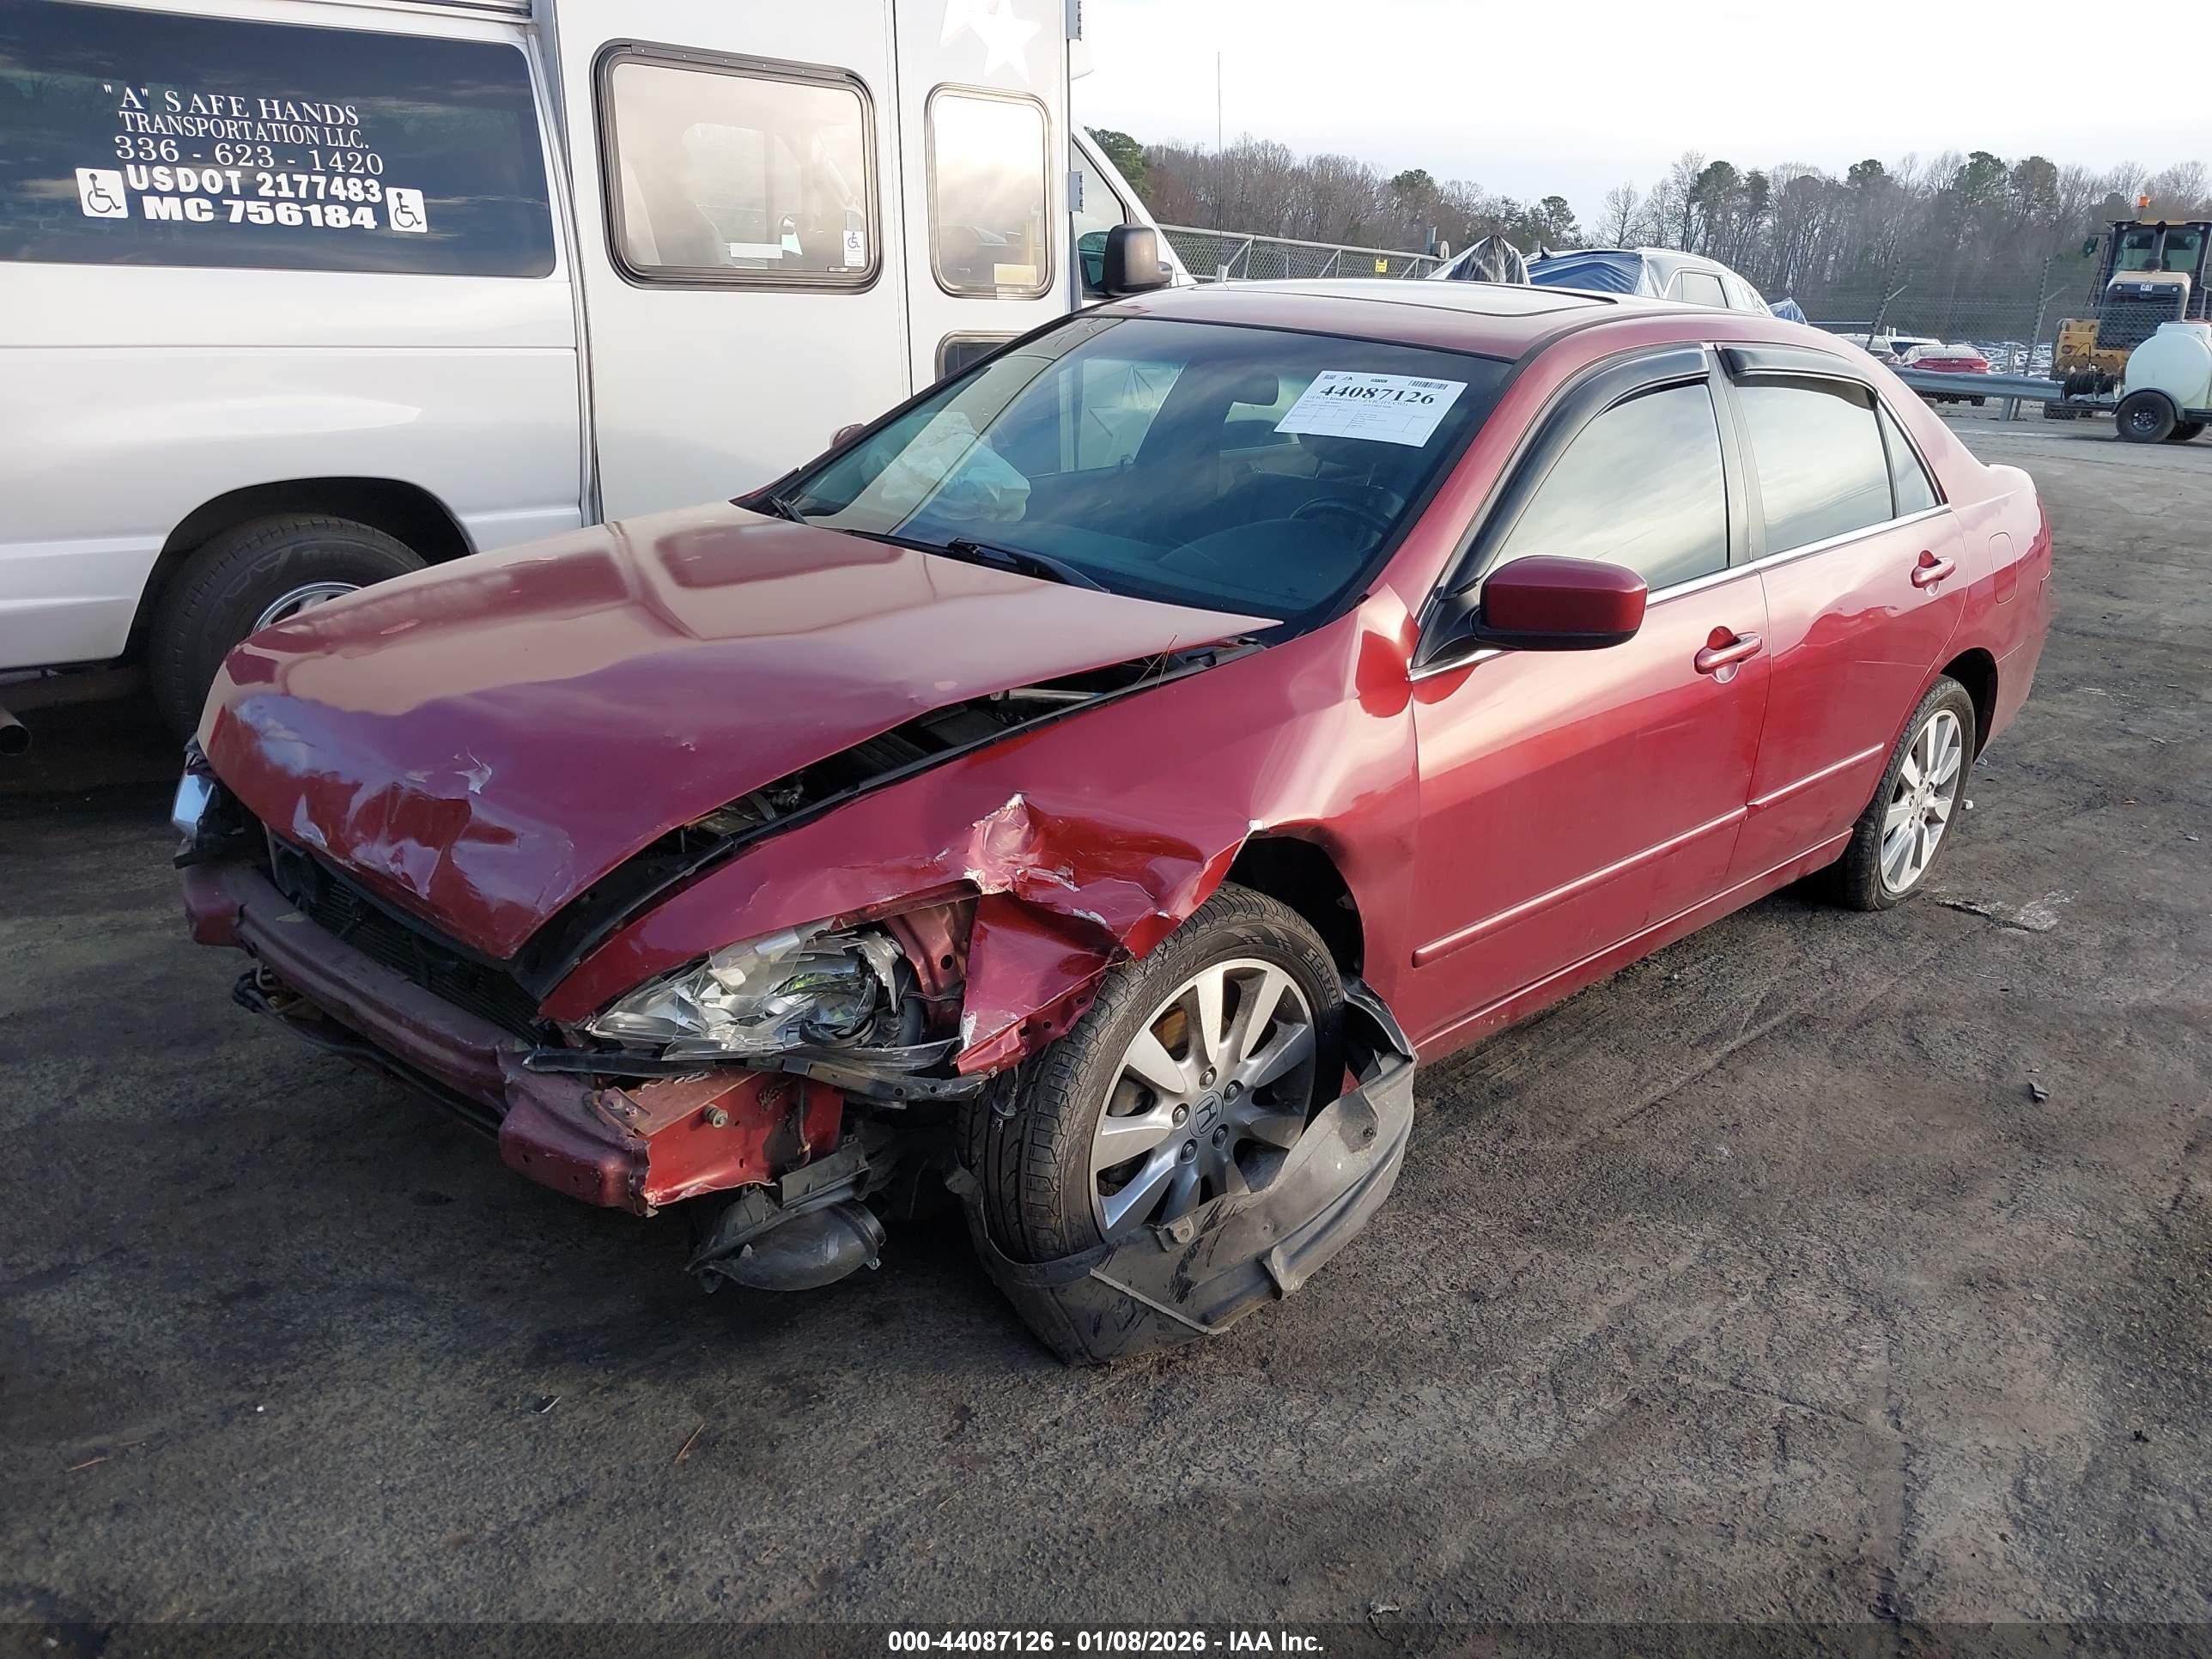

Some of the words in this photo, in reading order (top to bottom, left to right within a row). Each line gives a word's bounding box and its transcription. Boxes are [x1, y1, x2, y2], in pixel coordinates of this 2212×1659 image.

[118, 111, 320, 145] TRANSPORTATION
[323, 126, 369, 149] LLC.
[257, 98, 359, 126] HANDS
[114, 135, 179, 162] 336
[215, 143, 275, 168] 623
[309, 149, 384, 175] 1420
[125, 164, 241, 195] USDOT
[256, 172, 382, 204] 2177483
[142, 195, 215, 222] MC
[222, 199, 378, 229] 756184
[1319, 385, 1437, 405] 44087126
